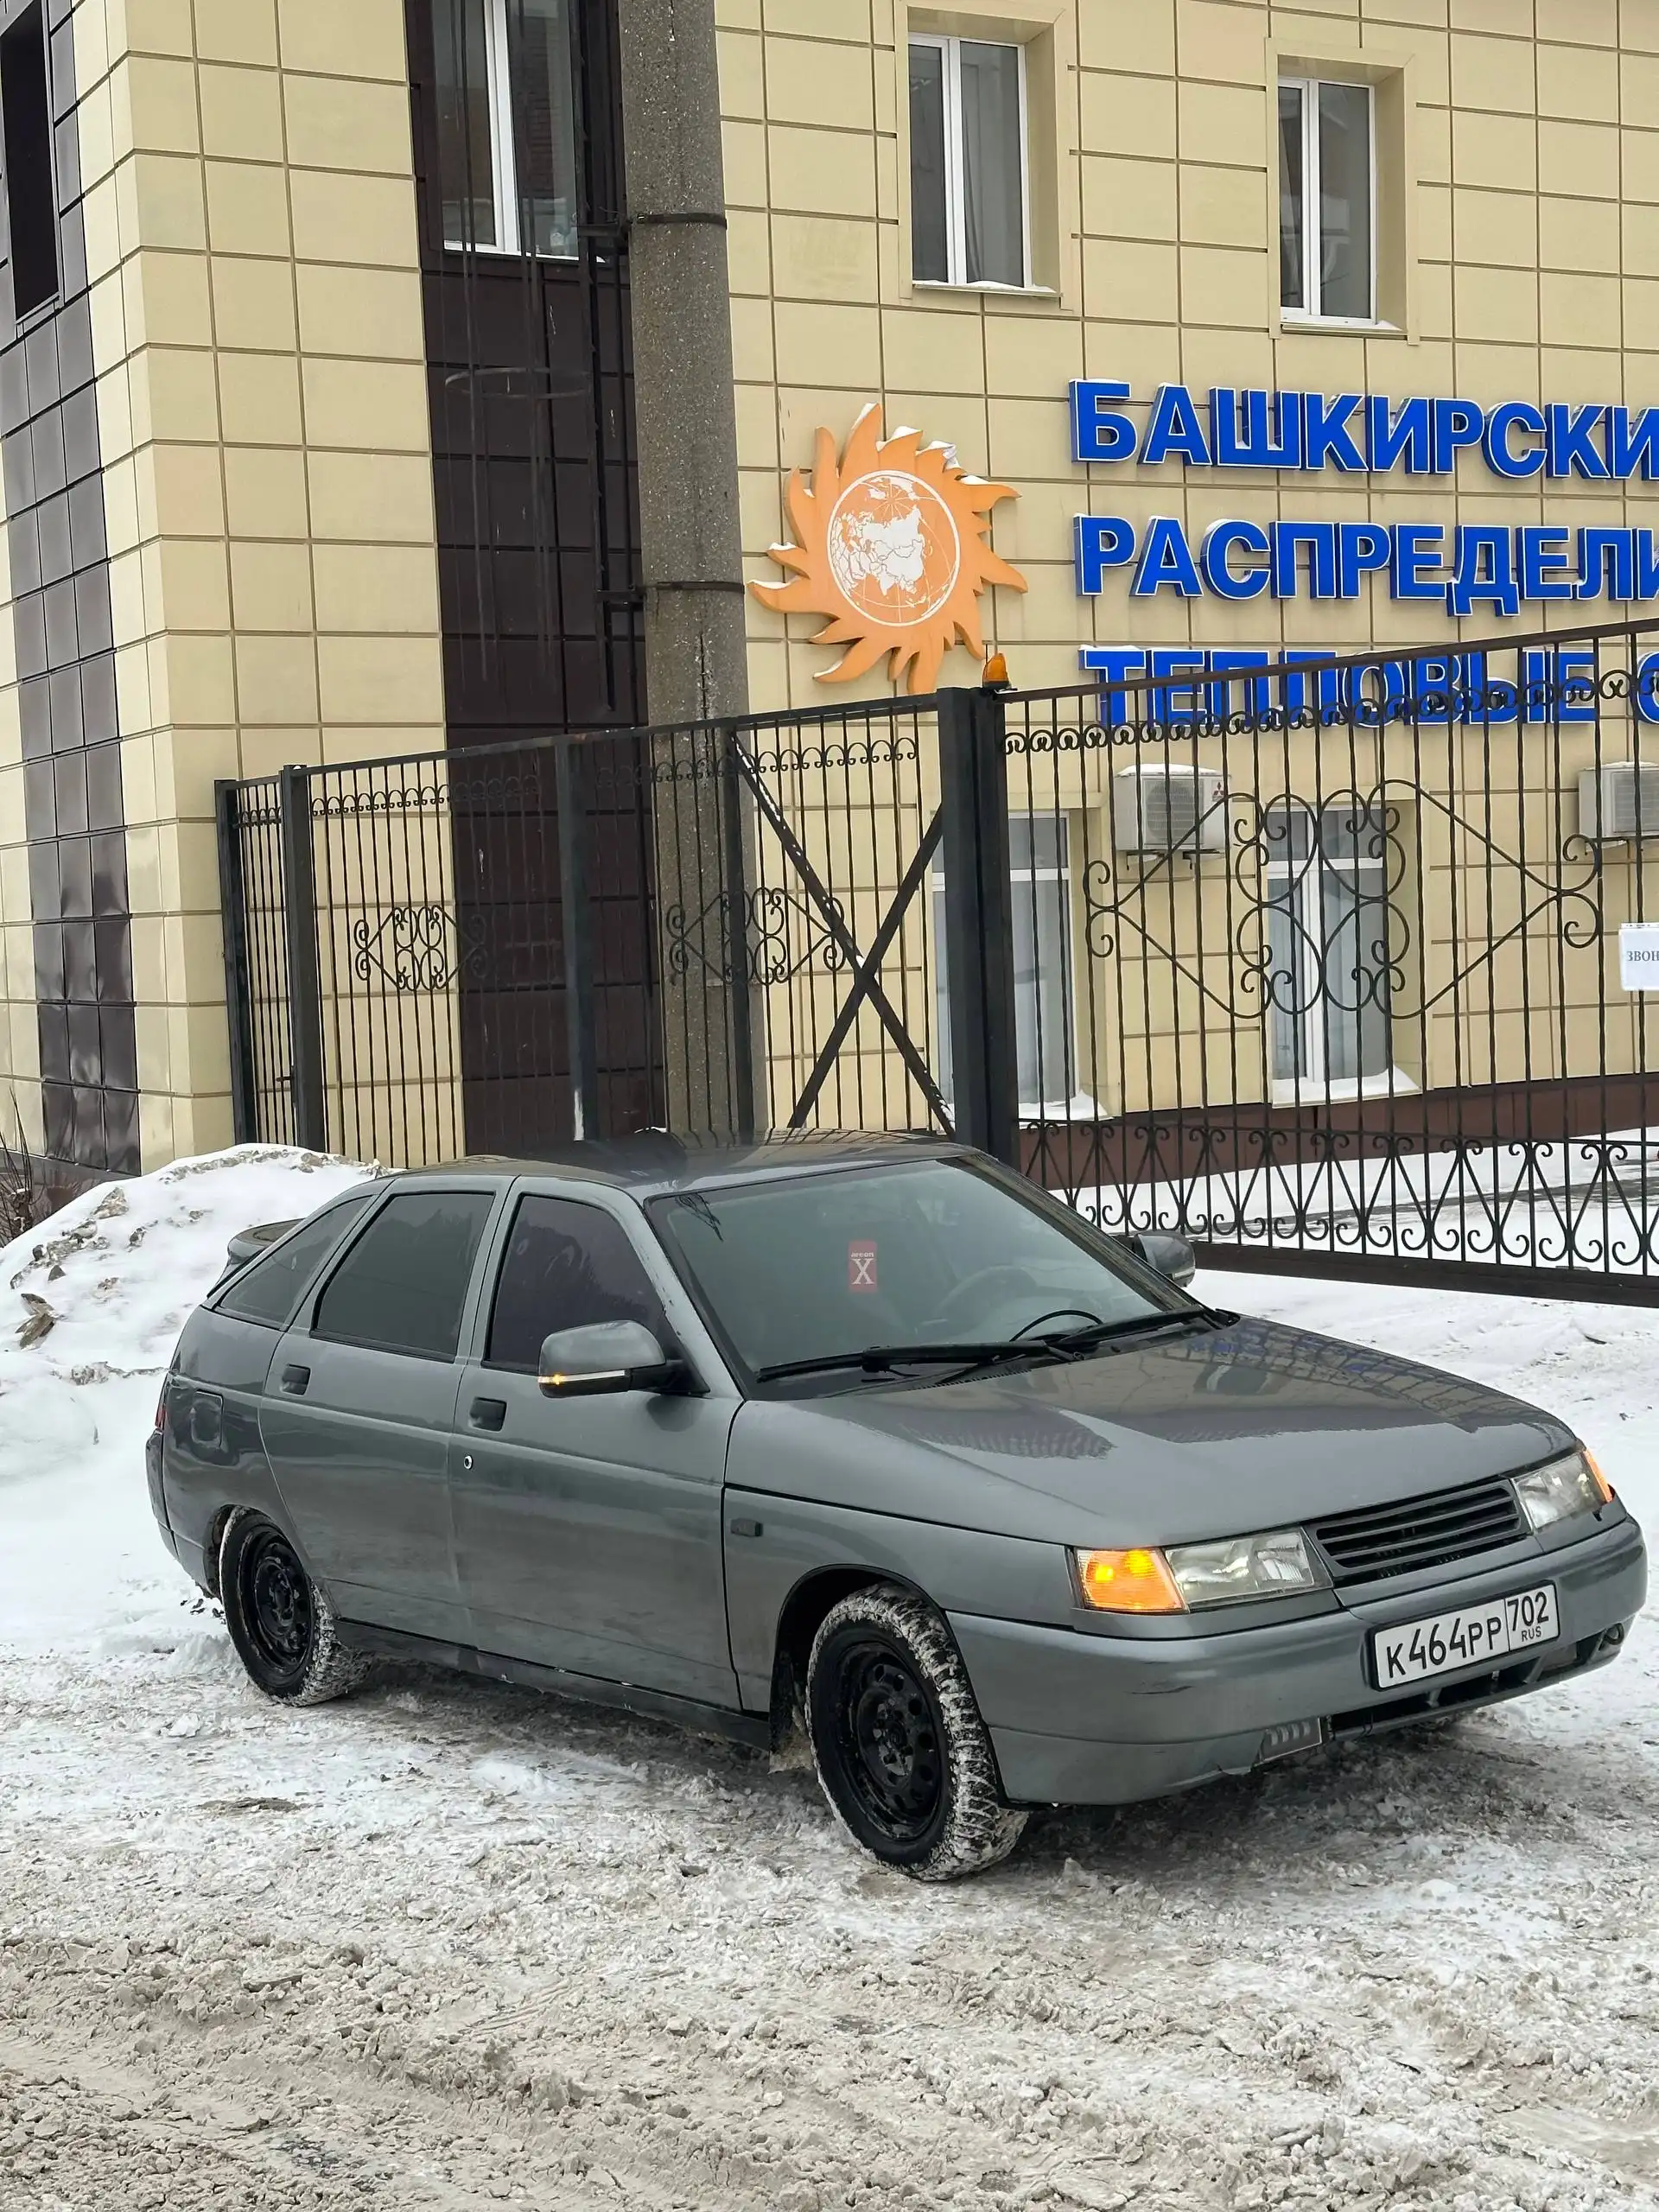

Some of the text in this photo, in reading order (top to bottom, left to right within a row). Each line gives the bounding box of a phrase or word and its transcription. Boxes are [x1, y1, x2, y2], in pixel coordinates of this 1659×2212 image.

[1069, 379, 1659, 480] БАШКИРСКИ
[1078, 647, 1597, 728] ТЕПЛОВЫЕ
[851, 1258, 874, 1285] X
[1507, 1592, 1549, 1632] 702
[1521, 1625, 1542, 1643] RUS
